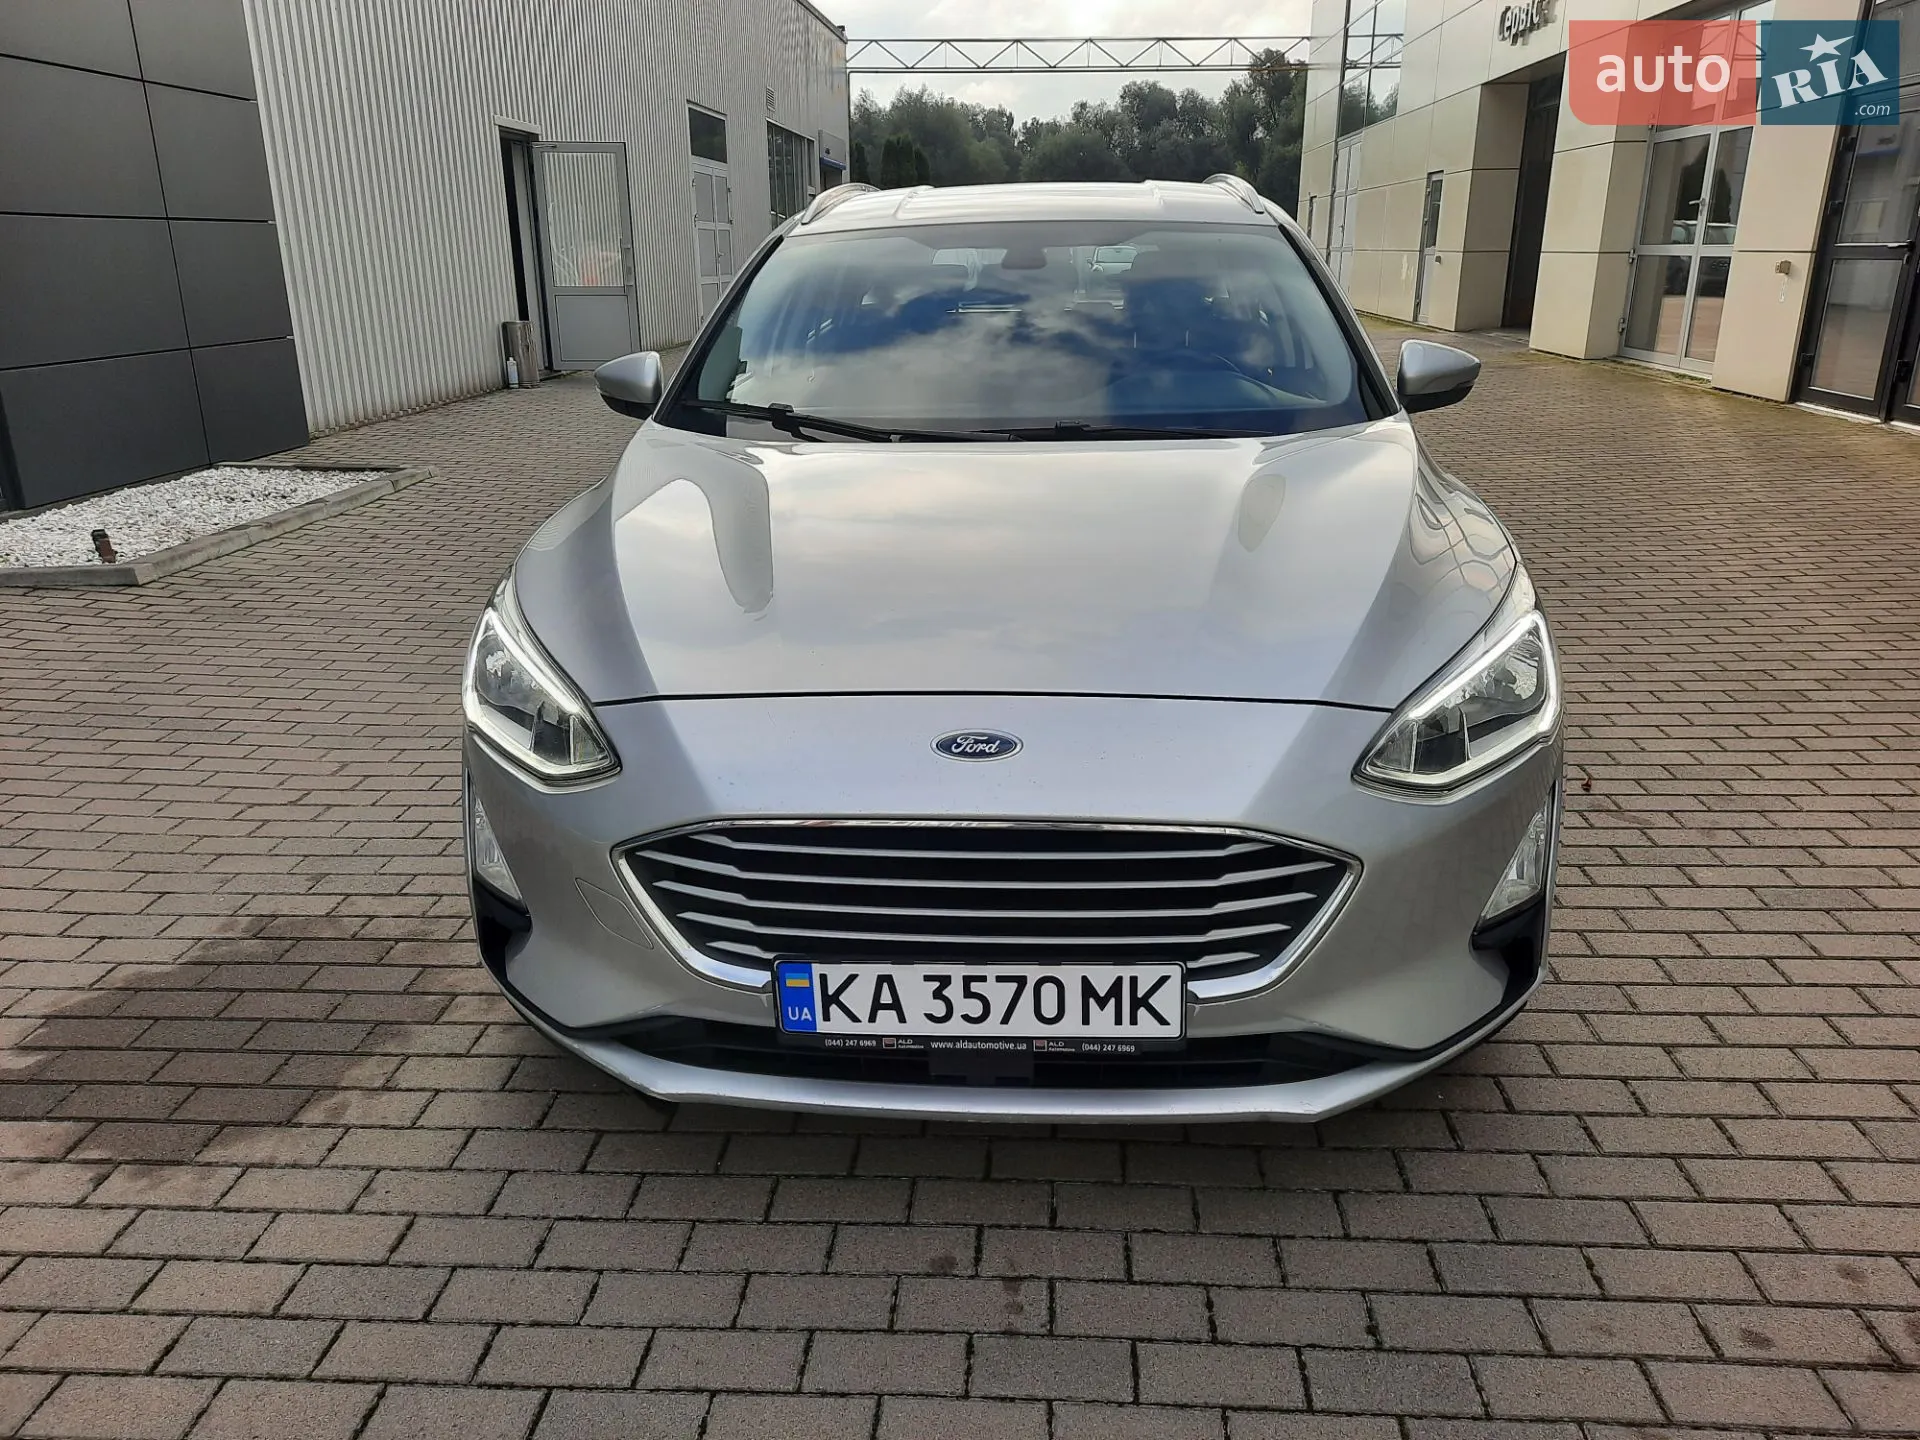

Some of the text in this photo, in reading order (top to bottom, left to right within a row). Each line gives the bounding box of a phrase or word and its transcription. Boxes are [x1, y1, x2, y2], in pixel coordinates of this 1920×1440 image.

[951, 735, 1001, 753] Ford
[819, 973, 1172, 1026] KA 3570 MK
[788, 1007, 812, 1022] UA
[824, 1039, 844, 1047] (044)
[845, 1039, 858, 1047] 247
[930, 1039, 1027, 1050] www.aldautomotive.ua
[1081, 1042, 1101, 1052] (044)
[1102, 1043, 1116, 1052] 247
